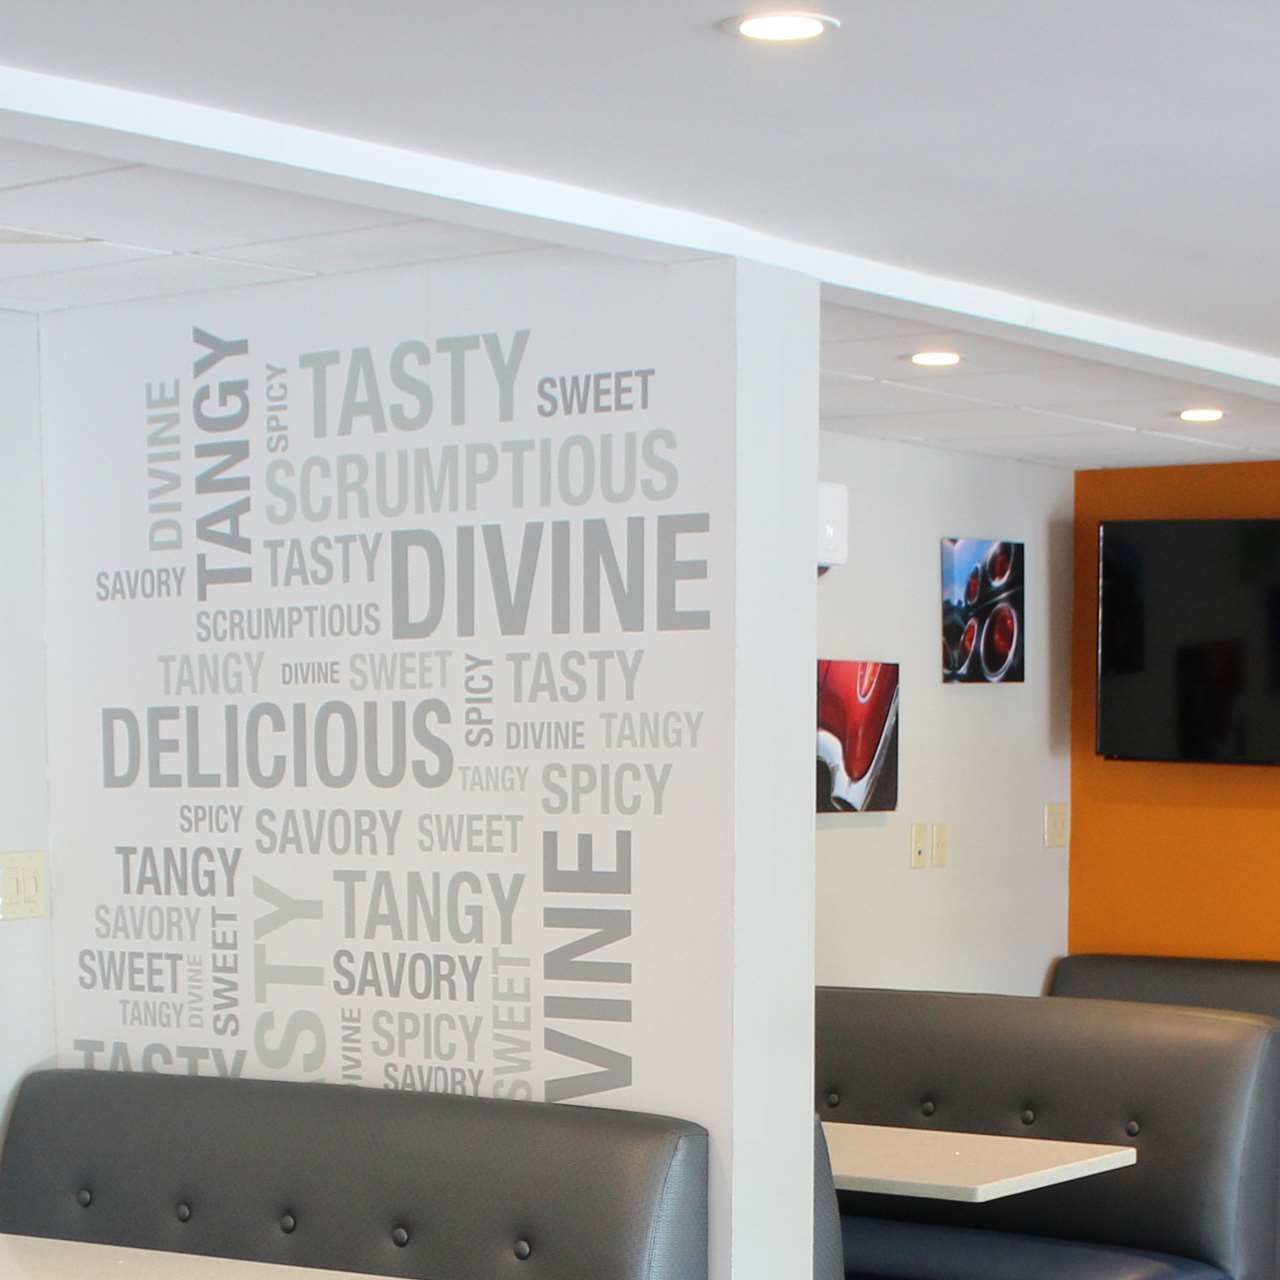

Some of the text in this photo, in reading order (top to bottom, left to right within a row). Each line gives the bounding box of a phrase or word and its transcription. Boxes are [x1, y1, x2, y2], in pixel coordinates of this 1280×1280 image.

[266, 363, 288, 453] SPICY
[298, 329, 531, 439] TASTY
[537, 369, 656, 417] SWEET
[146, 377, 182, 551] DIVINE
[193, 326, 252, 601] TANGY
[264, 428, 679, 526] SCRUMPTIOUS
[96, 567, 186, 601] SAVORY
[263, 533, 381, 587] TASTY
[390, 512, 710, 640] DIVINE
[196, 603, 380, 642] SCRUMPTIOUS
[158, 651, 264, 695] TANGY
[282, 661, 339, 685] DIVINE
[350, 651, 452, 692] SWEET
[506, 649, 644, 703] TASTY
[465, 654, 493, 747] SPICY
[102, 699, 453, 789] DELICIOUS
[507, 721, 584, 749] DIVINE
[601, 711, 704, 749] TANGY
[459, 766, 529, 792] TANGY
[542, 763, 672, 815] SPICY
[180, 805, 242, 833] SPICY
[255, 809, 401, 856] SAVORY
[418, 814, 523, 854] SWEET
[116, 846, 242, 897] TANGY
[95, 906, 200, 941] SAVORY
[333, 869, 525, 945] TANGY
[79, 949, 183, 993] SWEET
[186, 953, 203, 1029] DIVINE
[211, 906, 239, 1036] SWEET
[253, 876, 328, 1080] STY
[333, 950, 482, 1002] SAVORY
[120, 1000, 183, 1029] TANGY
[372, 1009, 483, 1062] SPICY
[491, 947, 533, 1101] SWEET
[383, 1062, 485, 1098] SAVORY
